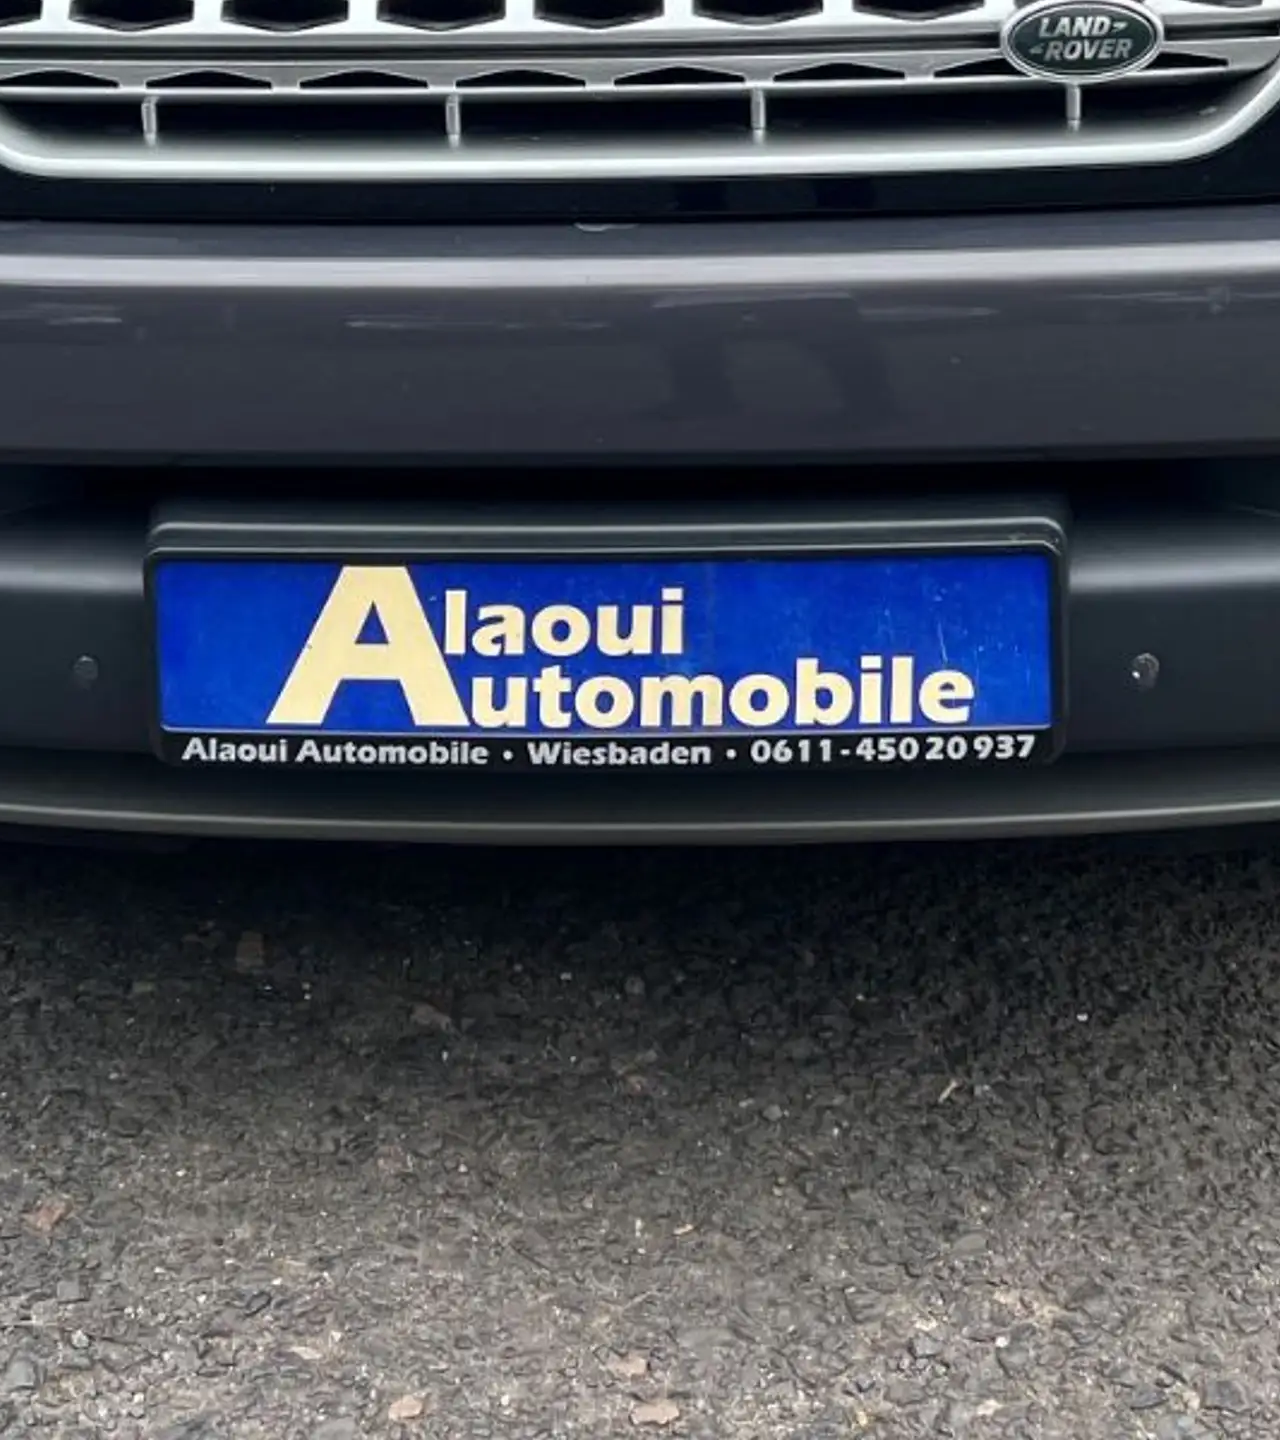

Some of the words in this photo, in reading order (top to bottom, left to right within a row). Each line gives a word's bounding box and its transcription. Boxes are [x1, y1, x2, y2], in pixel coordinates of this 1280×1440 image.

[1038, 16, 1111, 38] LAND
[1043, 38, 1134, 62] ROVER
[181, 737, 287, 763] Alaoui
[295, 738, 489, 766] Automobile
[526, 740, 712, 766] Wiesbaden
